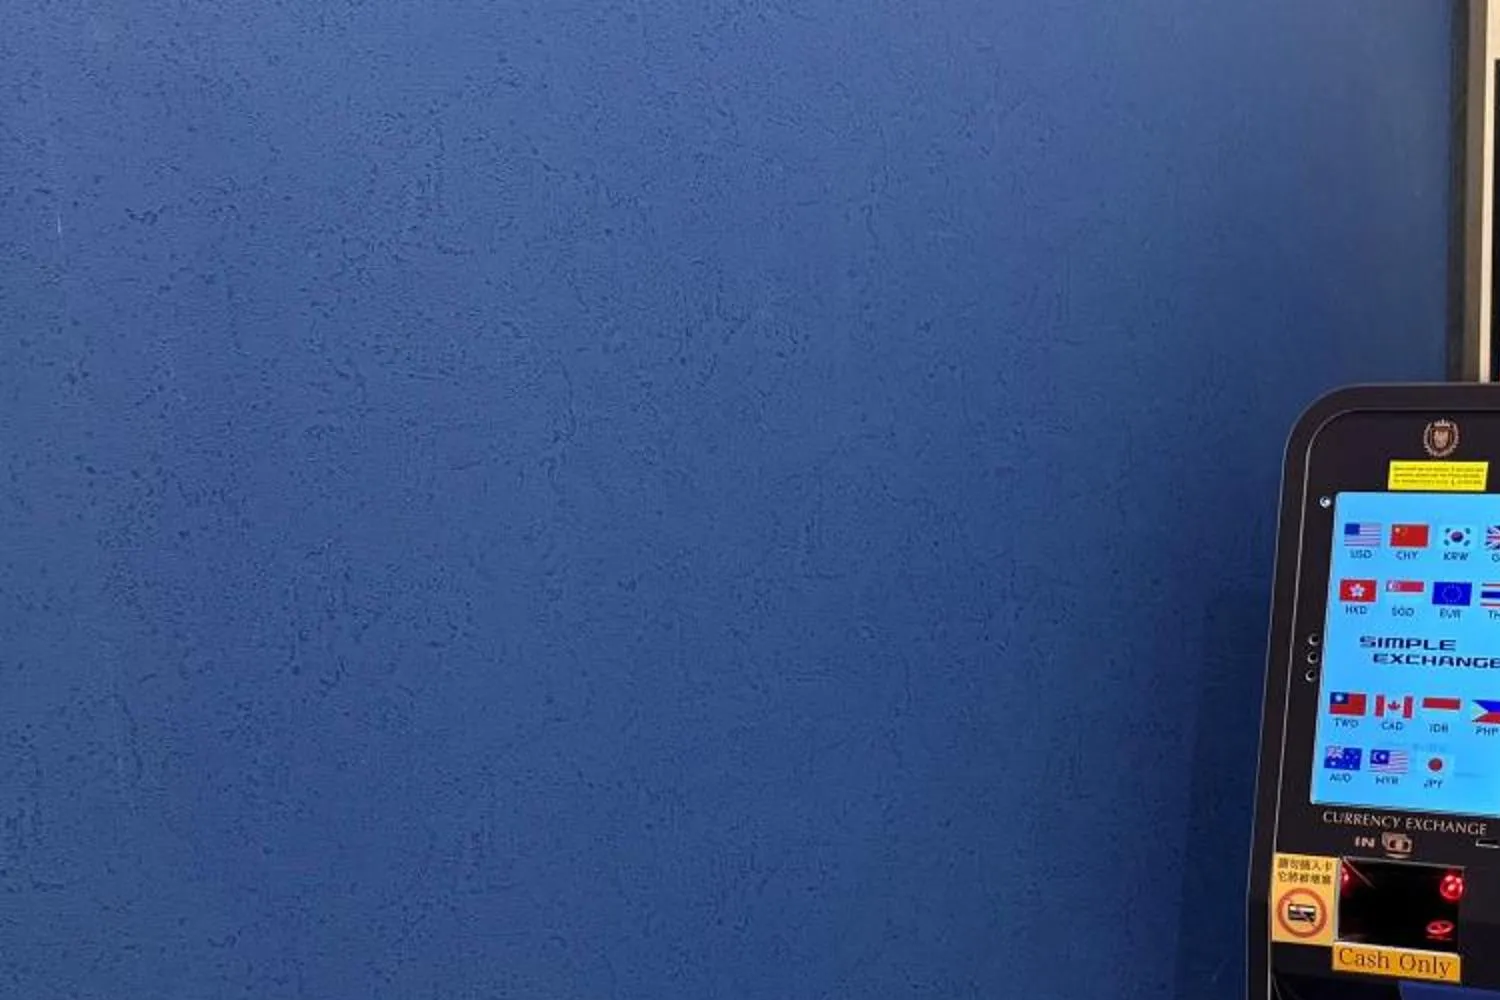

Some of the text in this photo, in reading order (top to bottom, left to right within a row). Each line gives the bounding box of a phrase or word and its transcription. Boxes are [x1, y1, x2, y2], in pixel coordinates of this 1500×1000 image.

[1350, 550, 1373, 560] USD
[1443, 552, 1469, 561] KRW
[1359, 635, 1457, 652] SIMPLE
[1381, 722, 1404, 732] CAD
[1475, 726, 1499, 737] PHP
[1322, 810, 1488, 836] CURRENCY EXCHANGE
[1354, 836, 1376, 849] IN
[1338, 946, 1453, 978] Cash Only
